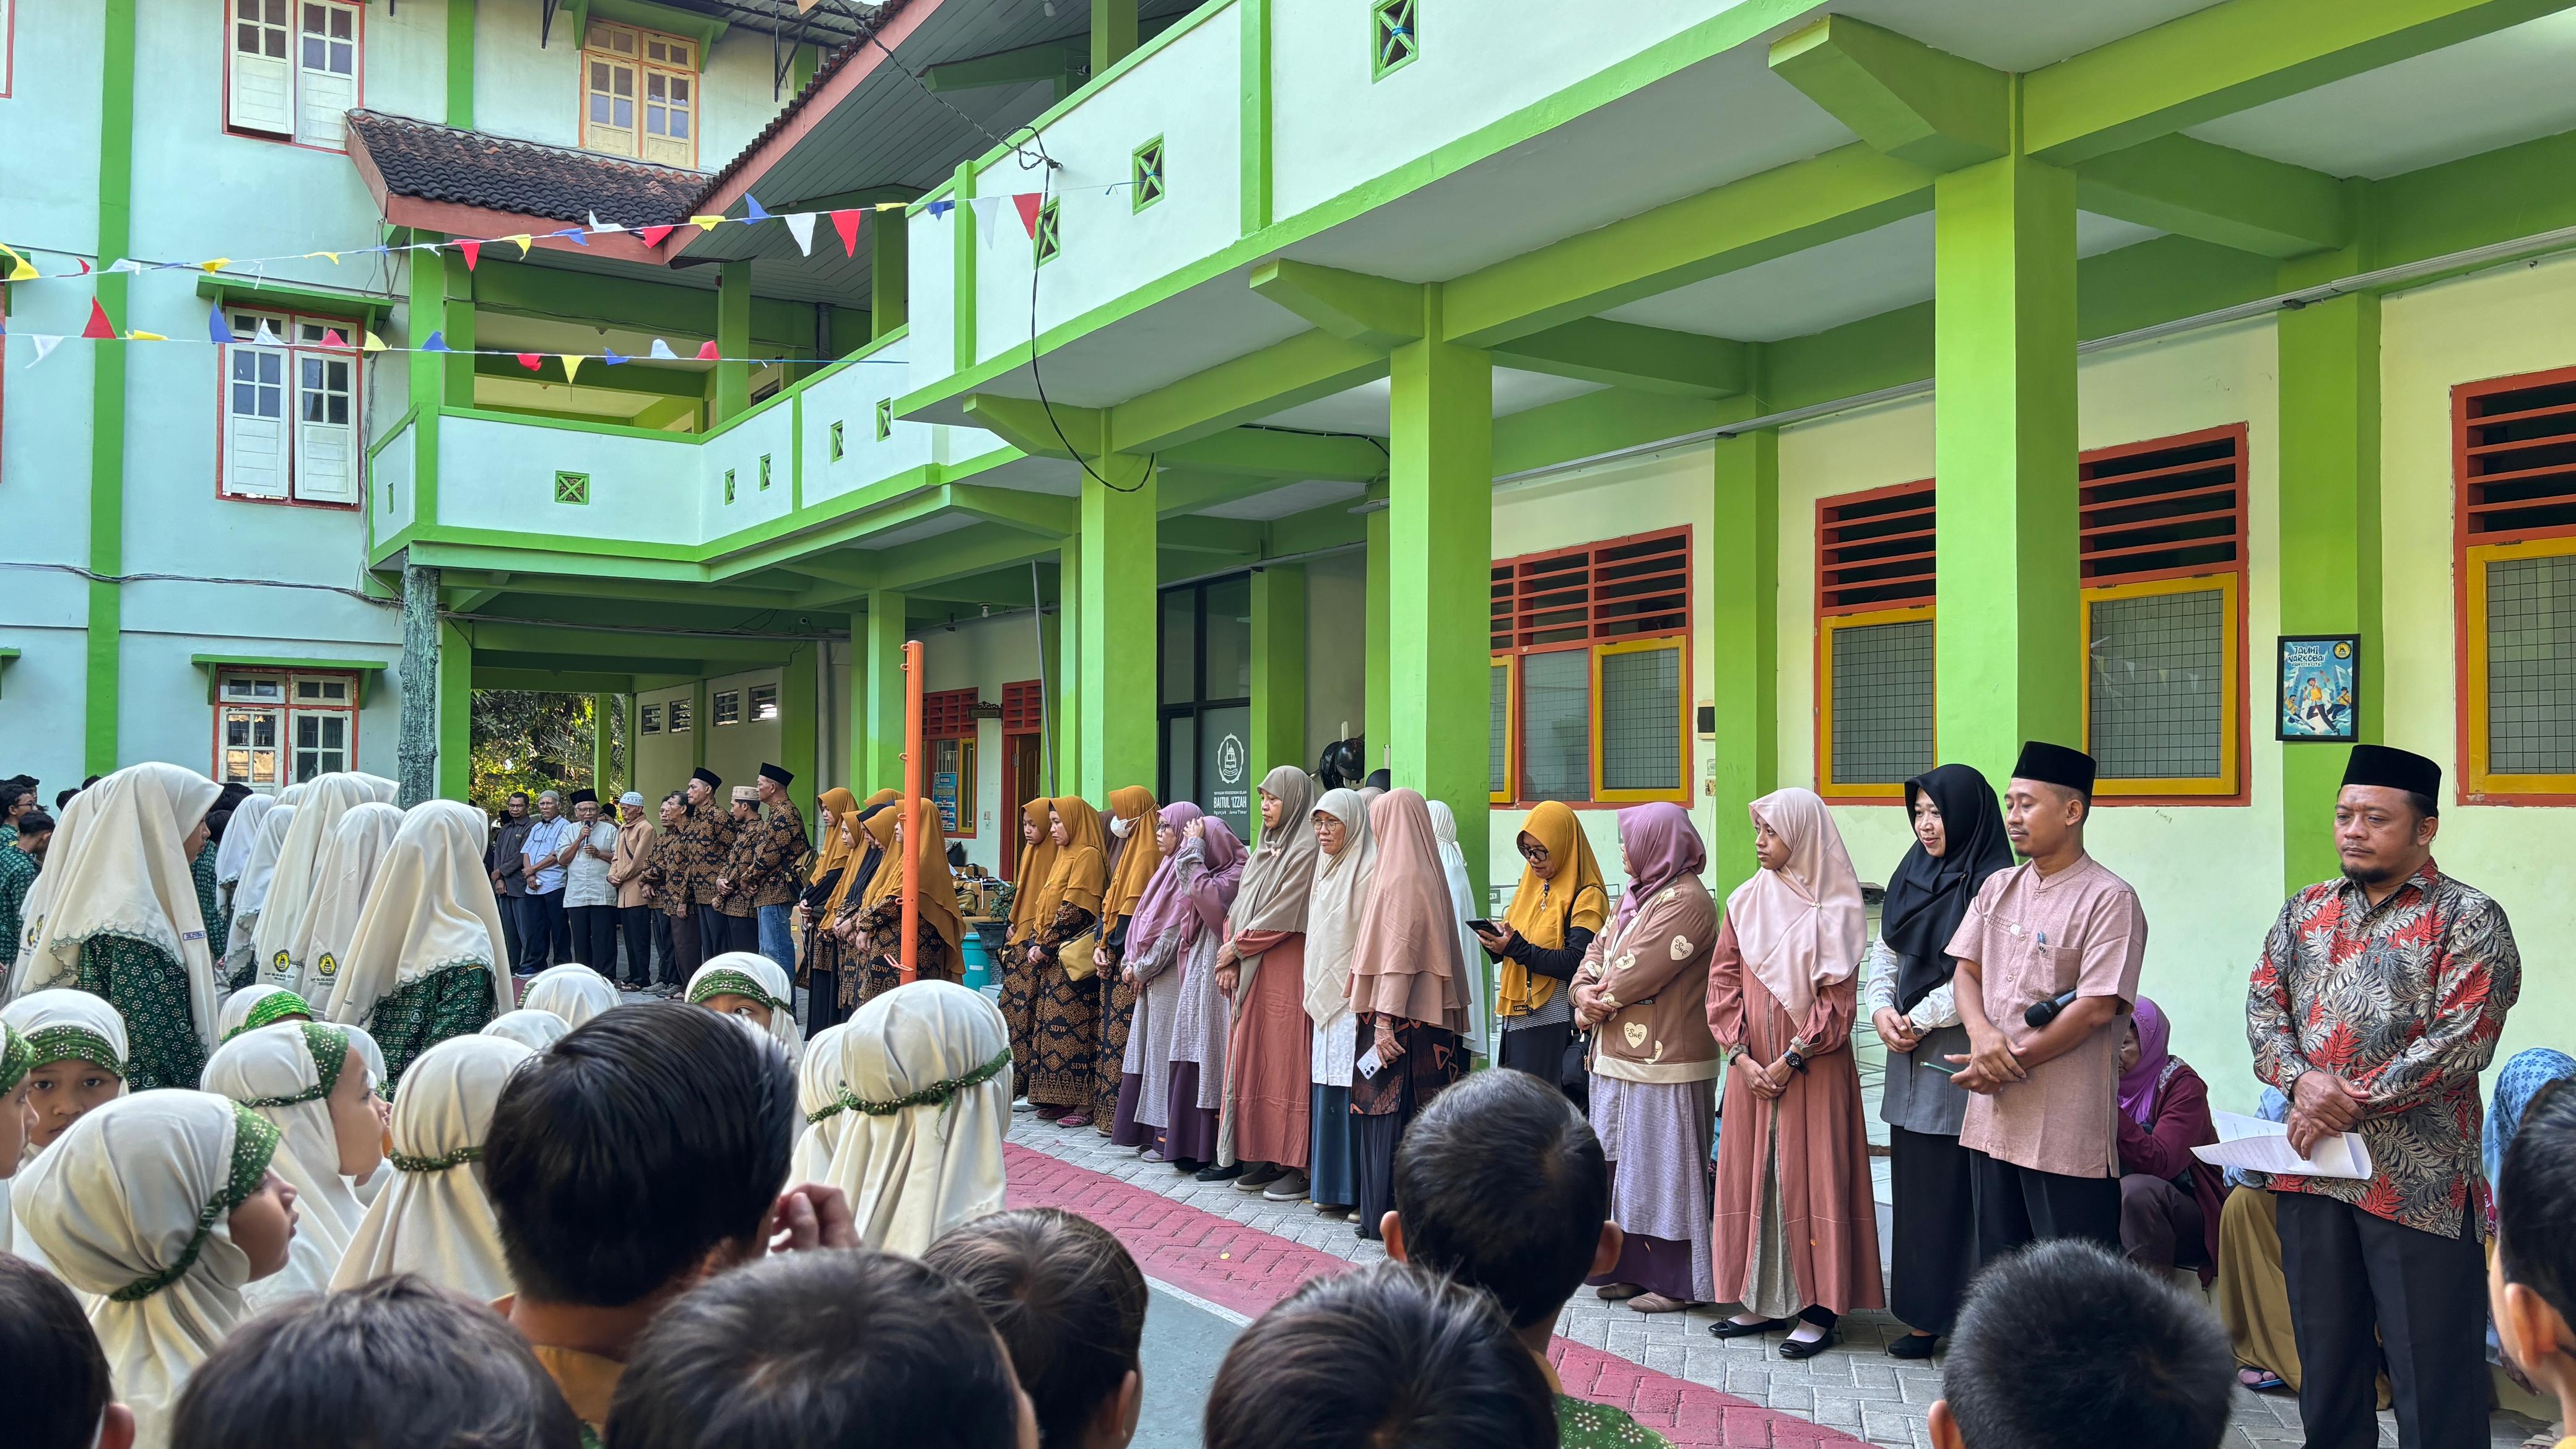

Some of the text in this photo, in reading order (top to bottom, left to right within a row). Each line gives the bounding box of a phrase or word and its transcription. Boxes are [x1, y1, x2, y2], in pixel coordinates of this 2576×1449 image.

[1214, 796, 1230, 808] BAITUL
[871, 964, 890, 973] SDW
[1013, 998, 1026, 1006] SDW
[1050, 1025, 1068, 1033] SDW
[1071, 1062, 1088, 1070] SDW
